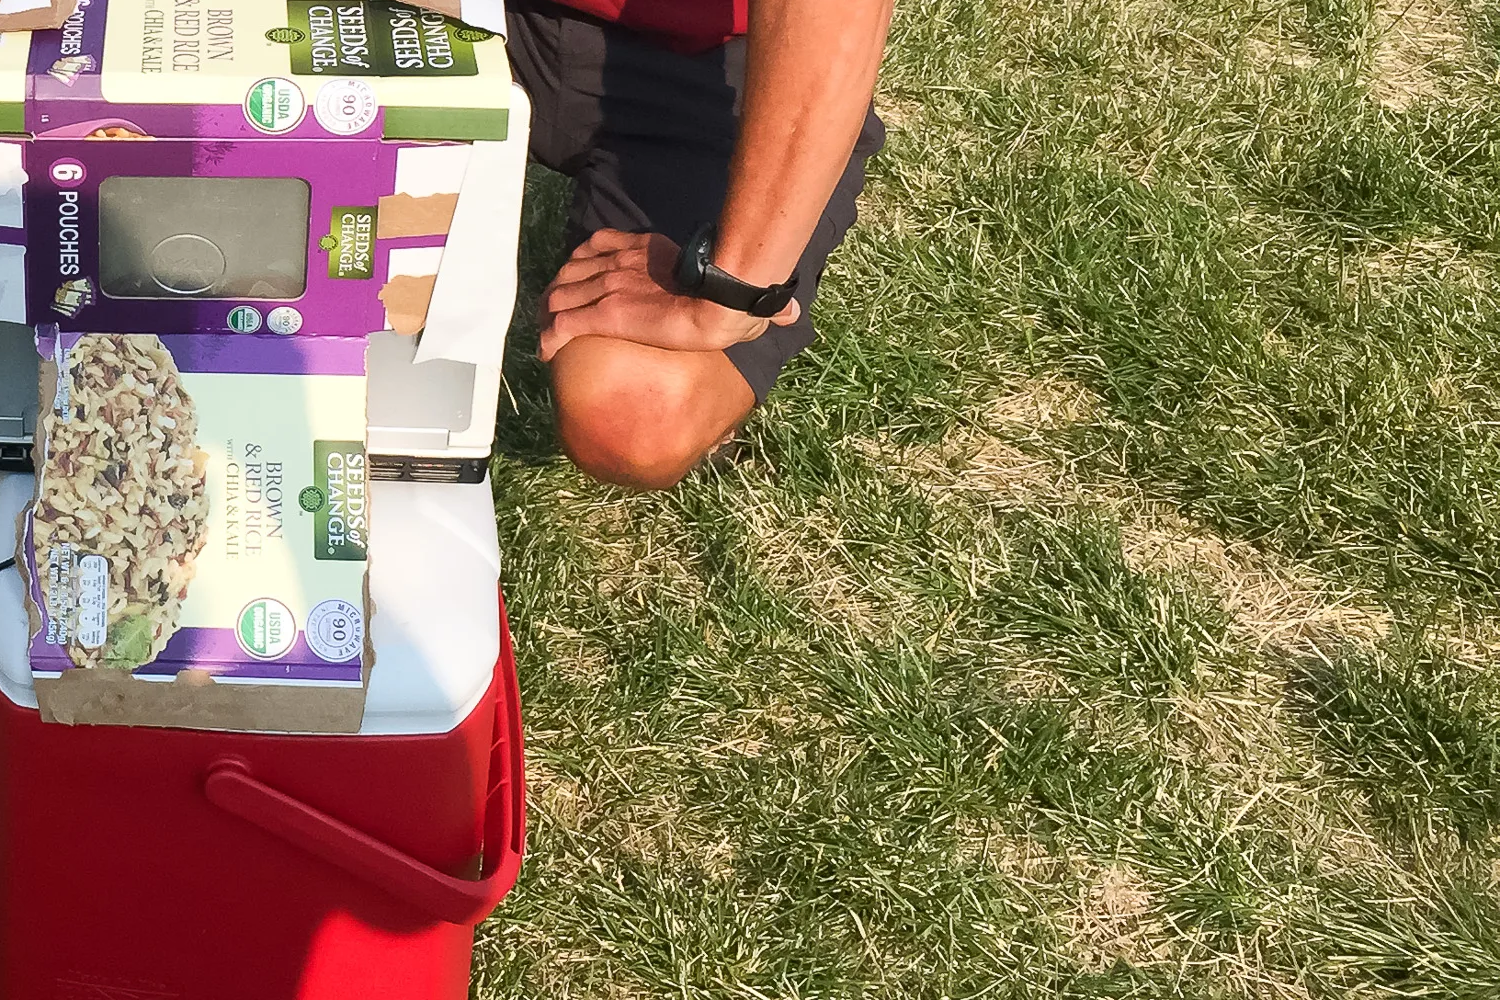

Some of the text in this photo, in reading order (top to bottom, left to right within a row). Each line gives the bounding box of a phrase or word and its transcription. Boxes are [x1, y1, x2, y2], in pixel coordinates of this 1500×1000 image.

[143, 10, 164, 35] CHIA
[174, 10, 200, 36] RED
[206, 9, 234, 61] BROWN
[336, 1, 370, 69] SEEDS of
[389, 6, 425, 69] SEEDS of
[141, 47, 162, 74] KALE
[172, 40, 200, 72] RICE
[261, 83, 273, 124] ORGANIC
[278, 89, 290, 120] USDA
[342, 94, 356, 116] 90
[347, 80, 373, 130] MICROWAVE
[53, 164, 83, 276] 6 POUCHES
[355, 214, 371, 260] SEEDS
[226, 463, 240, 502] CHIA
[245, 443, 263, 556] & RED RICE
[266, 462, 283, 539] BROWN
[346, 453, 366, 549] SEEDS of
[226, 504, 239, 516] &
[61, 543, 70, 561] NET
[226, 520, 239, 560] KALE
[61, 562, 70, 574] WT
[253, 606, 264, 649] ORGANIC
[269, 612, 281, 644] USDA
[332, 618, 346, 641] 90
[337, 603, 360, 656] MICROWAVE
